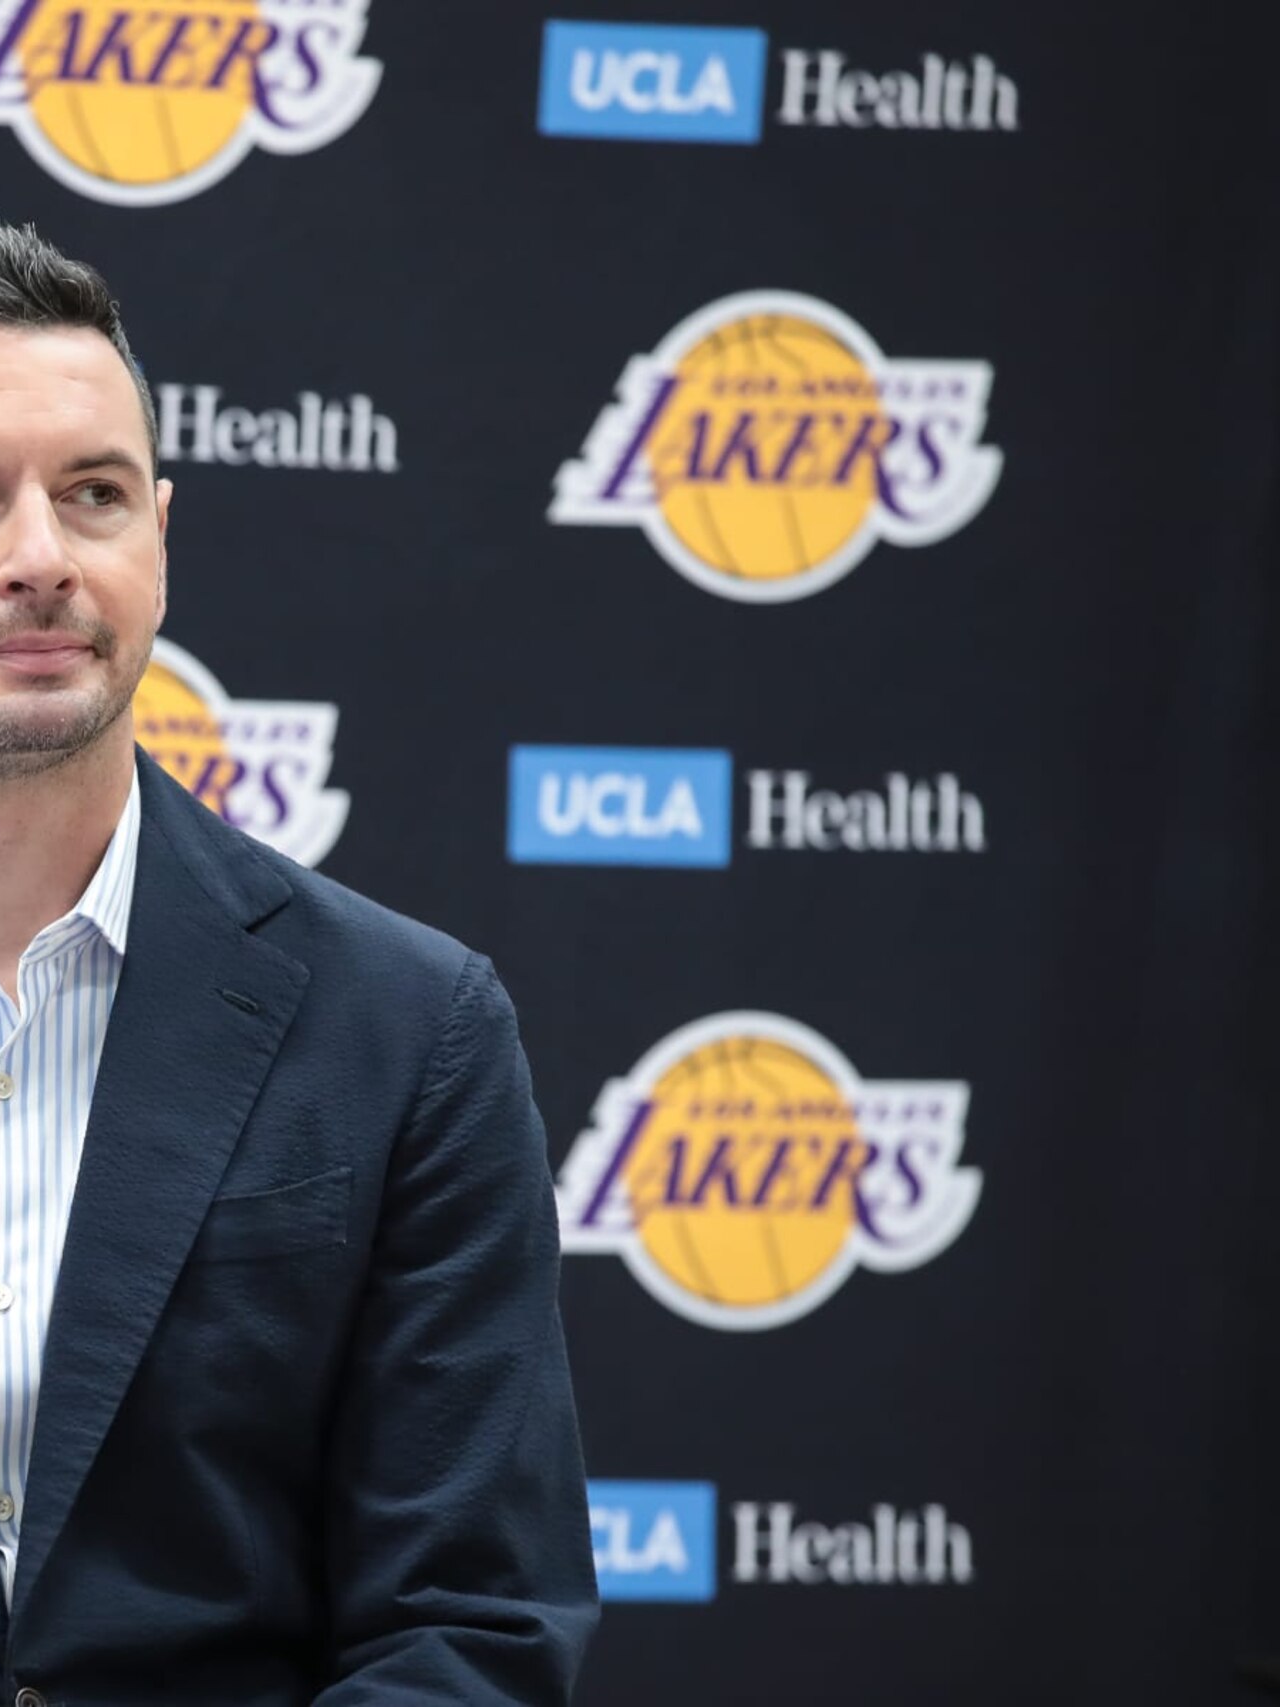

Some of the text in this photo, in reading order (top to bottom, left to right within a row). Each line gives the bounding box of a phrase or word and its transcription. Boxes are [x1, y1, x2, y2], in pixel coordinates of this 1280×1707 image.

[569, 48, 1018, 130] UCLA Health
[158, 382, 399, 473] Health
[598, 375, 964, 521] LAKERS
[537, 768, 986, 852] UCLA Health
[577, 1099, 942, 1249] LAKERS
[732, 1500, 974, 1584] Health
